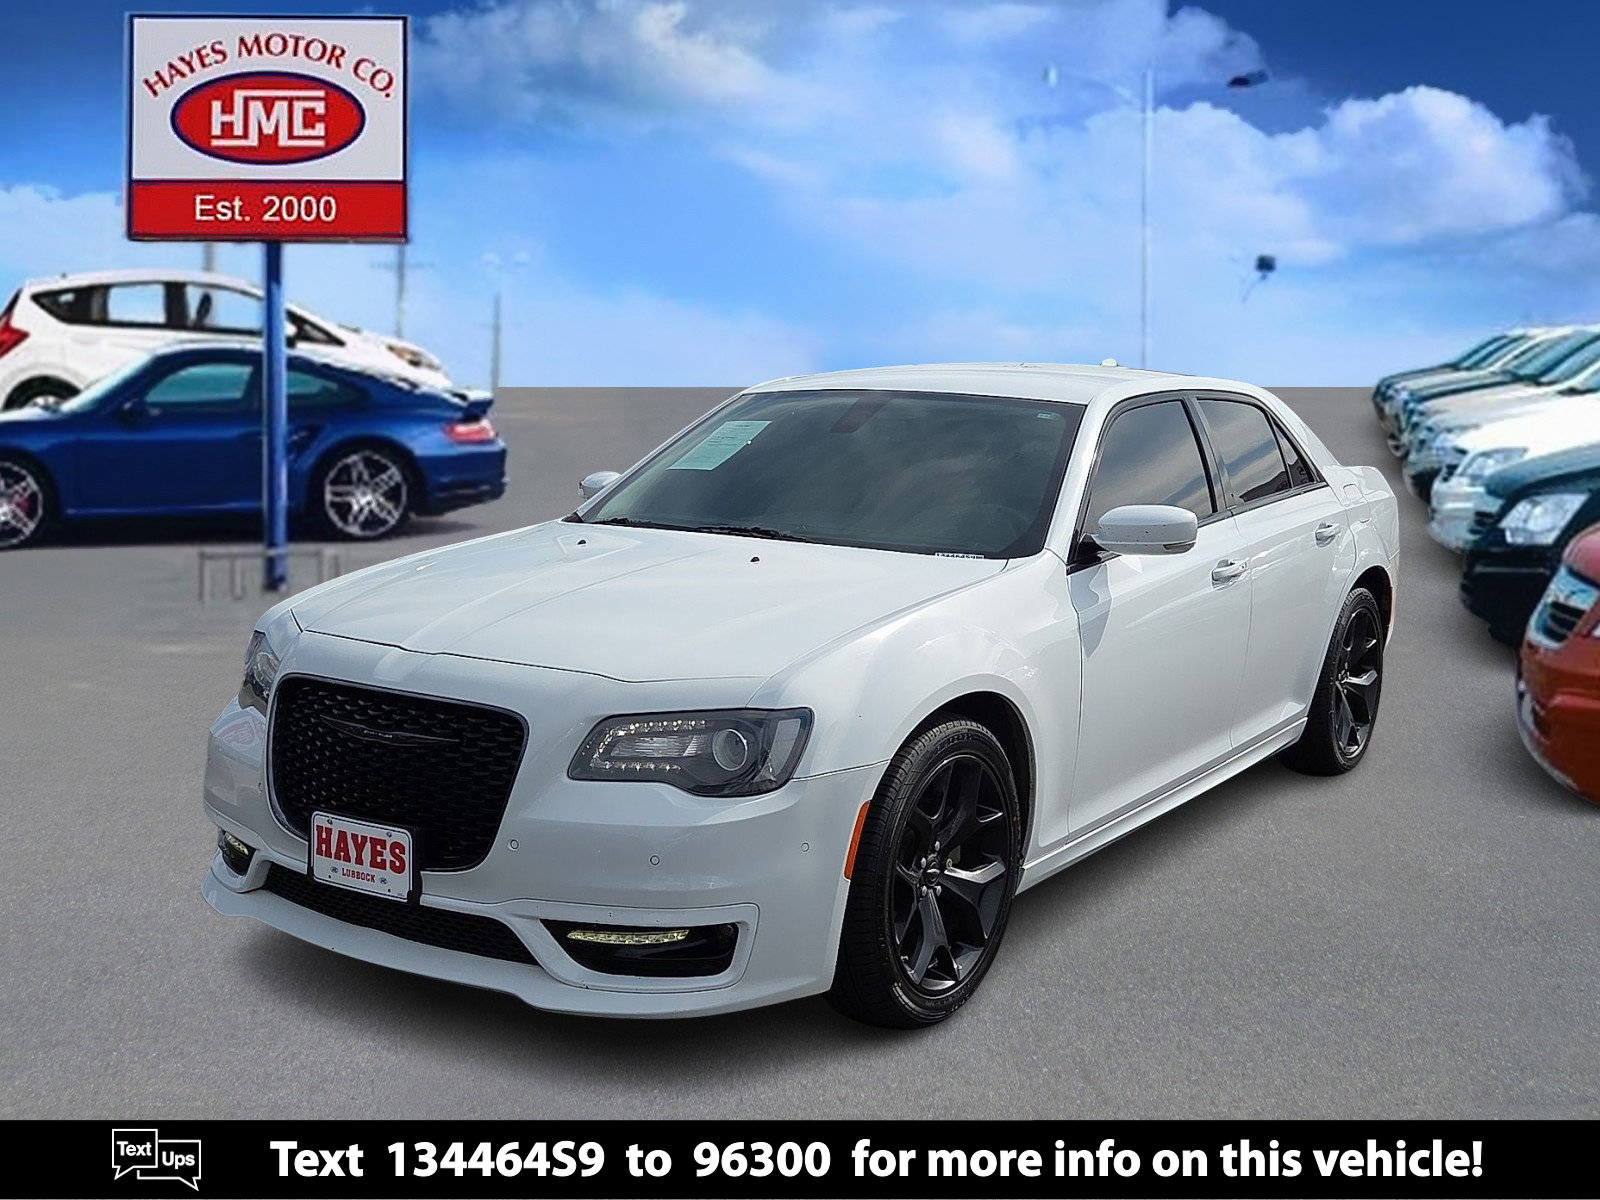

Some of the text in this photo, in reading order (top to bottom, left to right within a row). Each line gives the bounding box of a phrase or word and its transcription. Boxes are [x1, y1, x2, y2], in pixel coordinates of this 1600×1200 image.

[142, 32, 395, 99] HAYES MOTOR CO.
[210, 88, 326, 147] HMC
[194, 194, 337, 222] Est. 2000
[316, 825, 406, 875] HAYES
[341, 868, 376, 883] LUBBOCK
